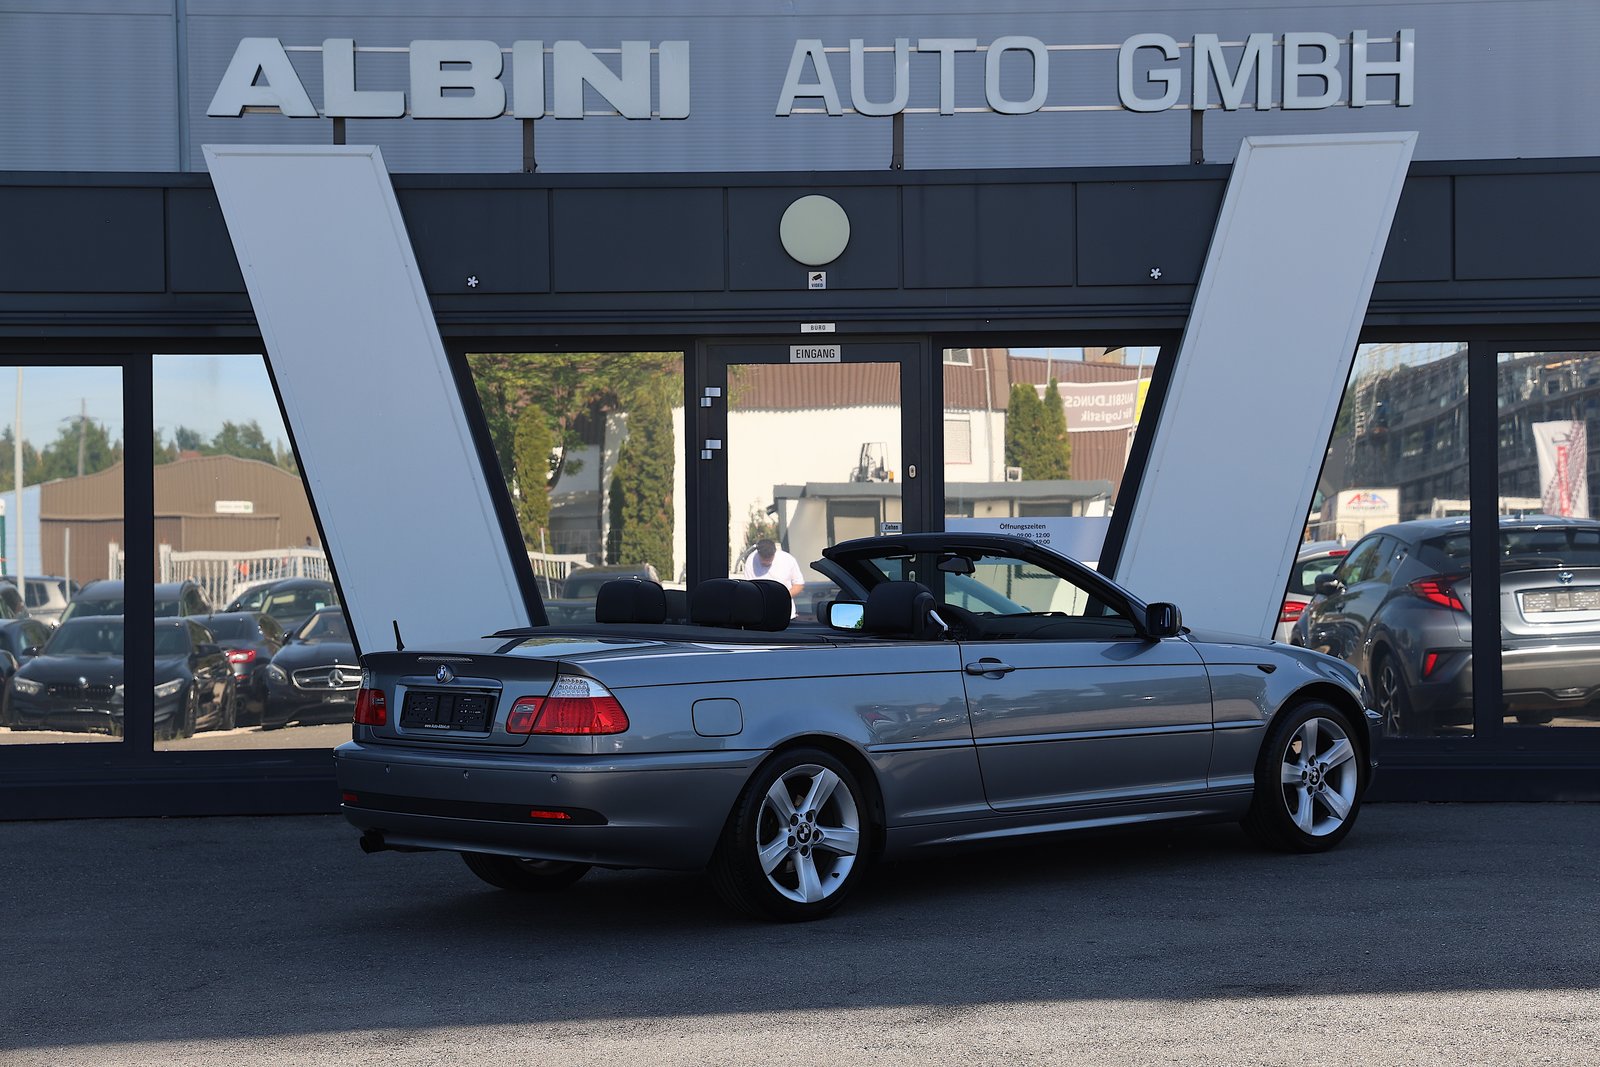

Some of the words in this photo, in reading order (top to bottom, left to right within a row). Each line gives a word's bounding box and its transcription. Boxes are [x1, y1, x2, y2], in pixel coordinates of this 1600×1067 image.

[206, 37, 690, 119] ALBINI
[775, 36, 1049, 117] AUTO
[1118, 29, 1415, 113] GMBH
[796, 348, 835, 359] EINGANG
[999, 522, 1047, 531] Öffnungszeiten
